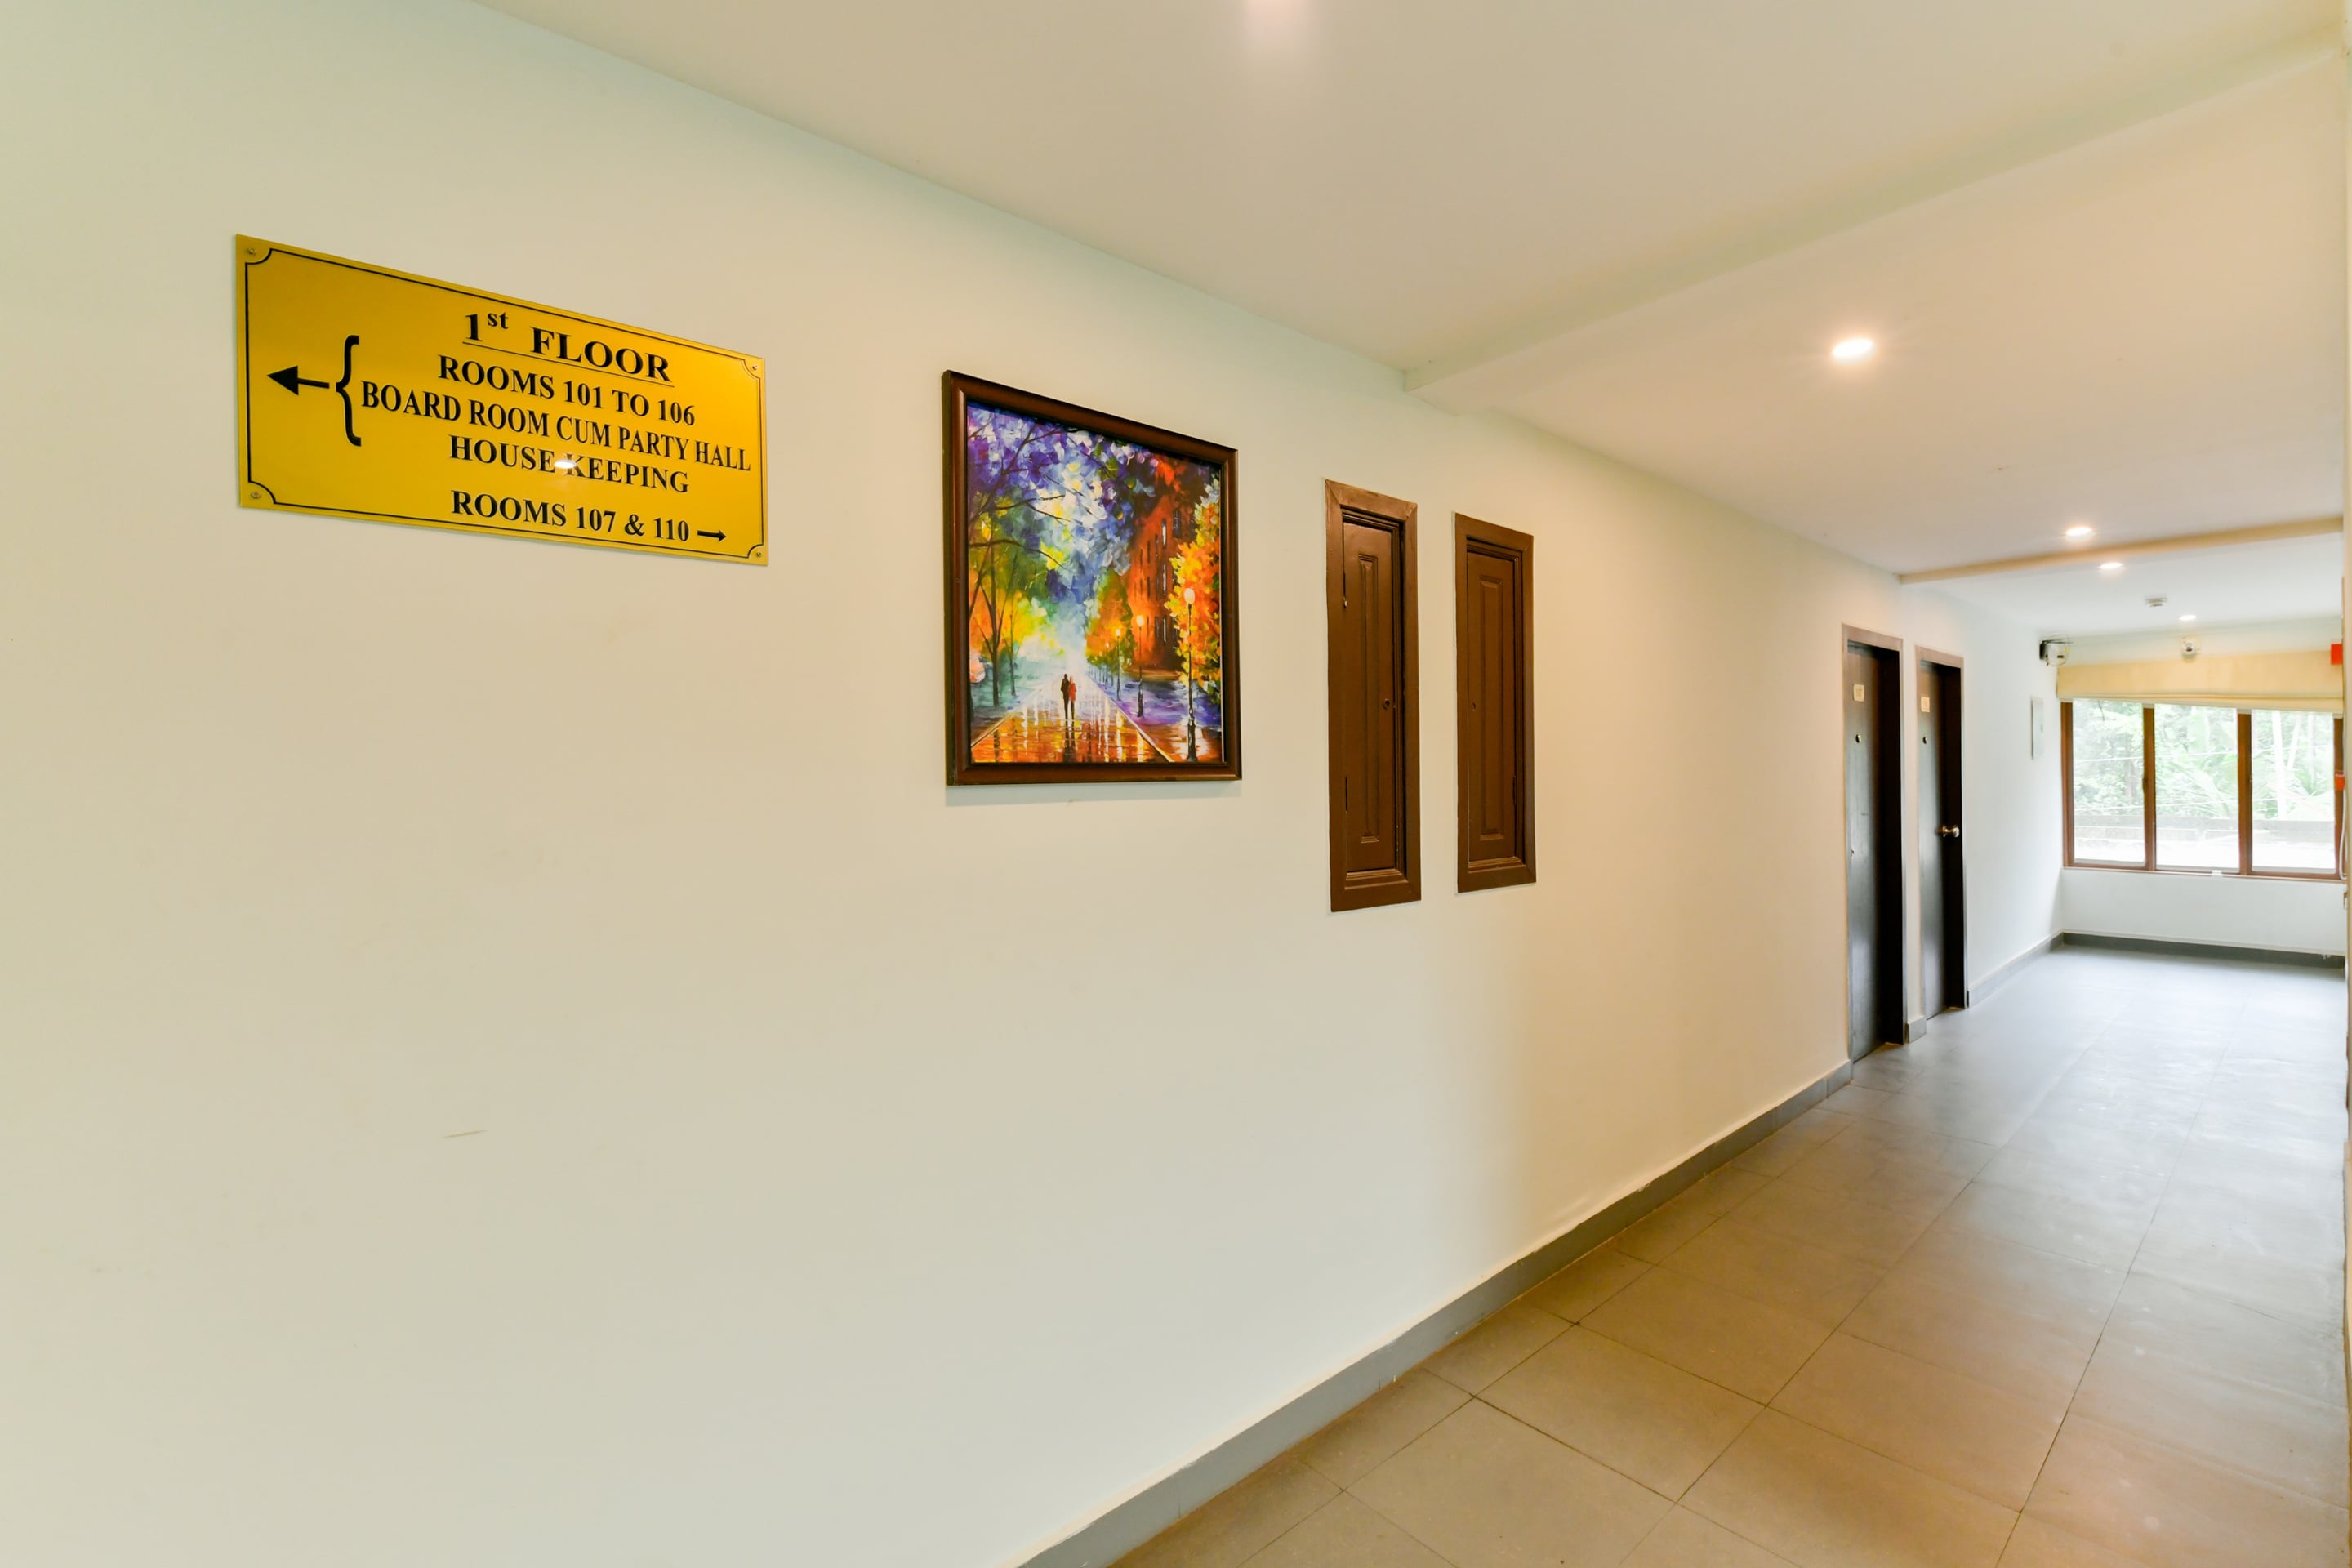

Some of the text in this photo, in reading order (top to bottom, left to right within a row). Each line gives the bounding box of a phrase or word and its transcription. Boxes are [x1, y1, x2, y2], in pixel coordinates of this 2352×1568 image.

[465, 310, 673, 382] 1st FLOOR
[361, 380, 751, 471] BOARD ROOM CUM PARTY HALL
[439, 354, 696, 426] ROOMS 101 TO 106
[450, 434, 688, 493] HOUSE KEEPING
[452, 489, 690, 542] ROOMS 107 & 110
